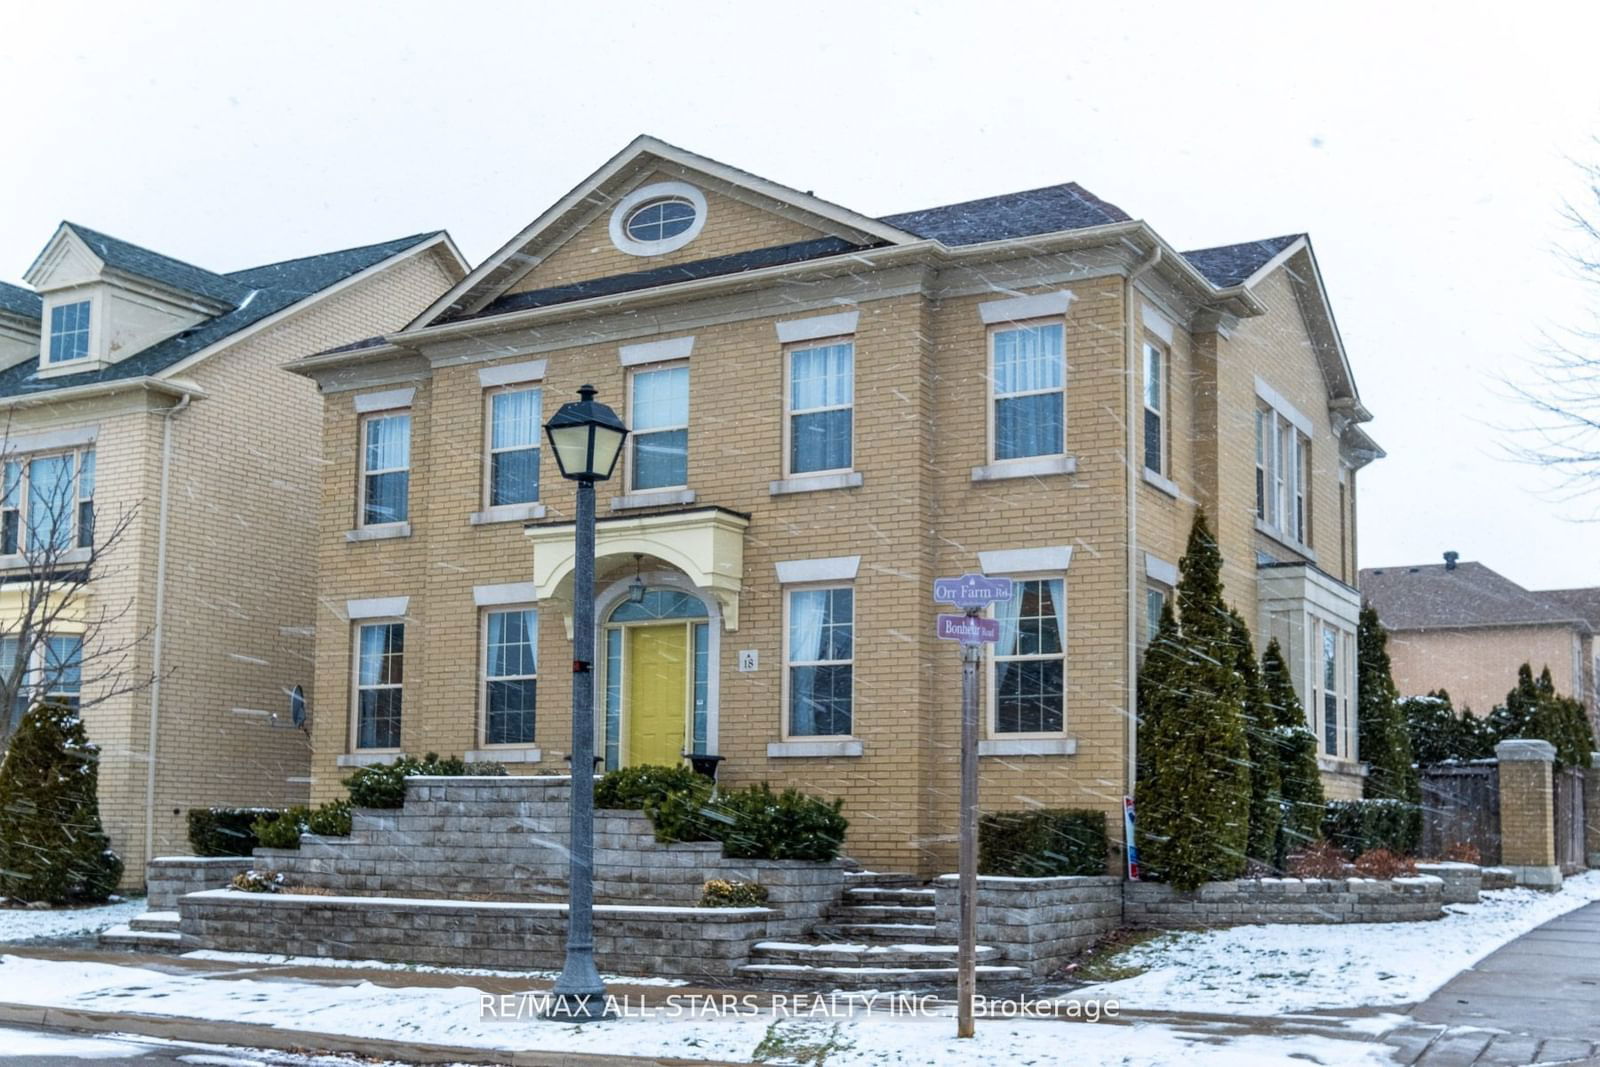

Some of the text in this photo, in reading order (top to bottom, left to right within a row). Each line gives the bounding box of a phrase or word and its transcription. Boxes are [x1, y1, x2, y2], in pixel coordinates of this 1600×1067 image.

[936, 585, 956, 599] Orr
[961, 584, 991, 598] Farm
[744, 658, 754, 669] 18
